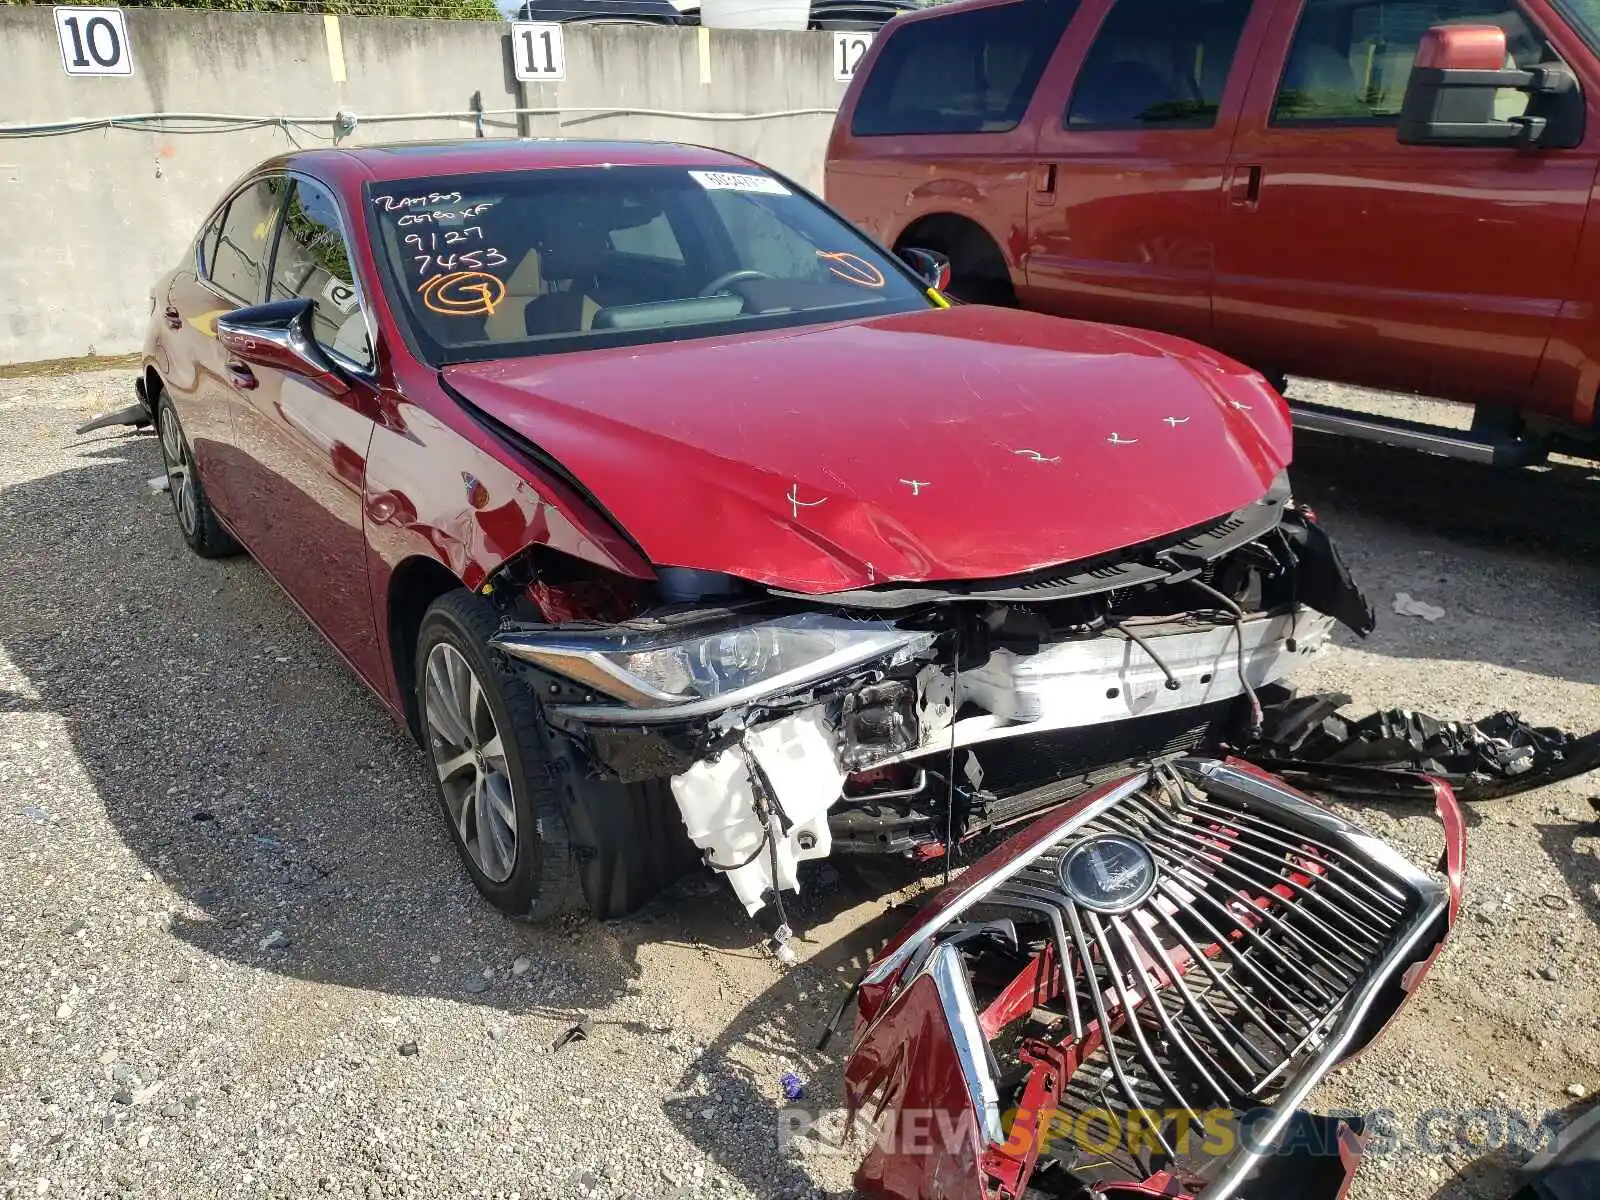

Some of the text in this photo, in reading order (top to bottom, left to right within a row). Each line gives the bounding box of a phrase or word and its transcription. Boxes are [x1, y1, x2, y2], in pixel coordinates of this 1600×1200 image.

[64, 16, 121, 67] 10
[521, 30, 557, 73] 11
[839, 38, 867, 75] 12
[414, 247, 508, 275] 7453
